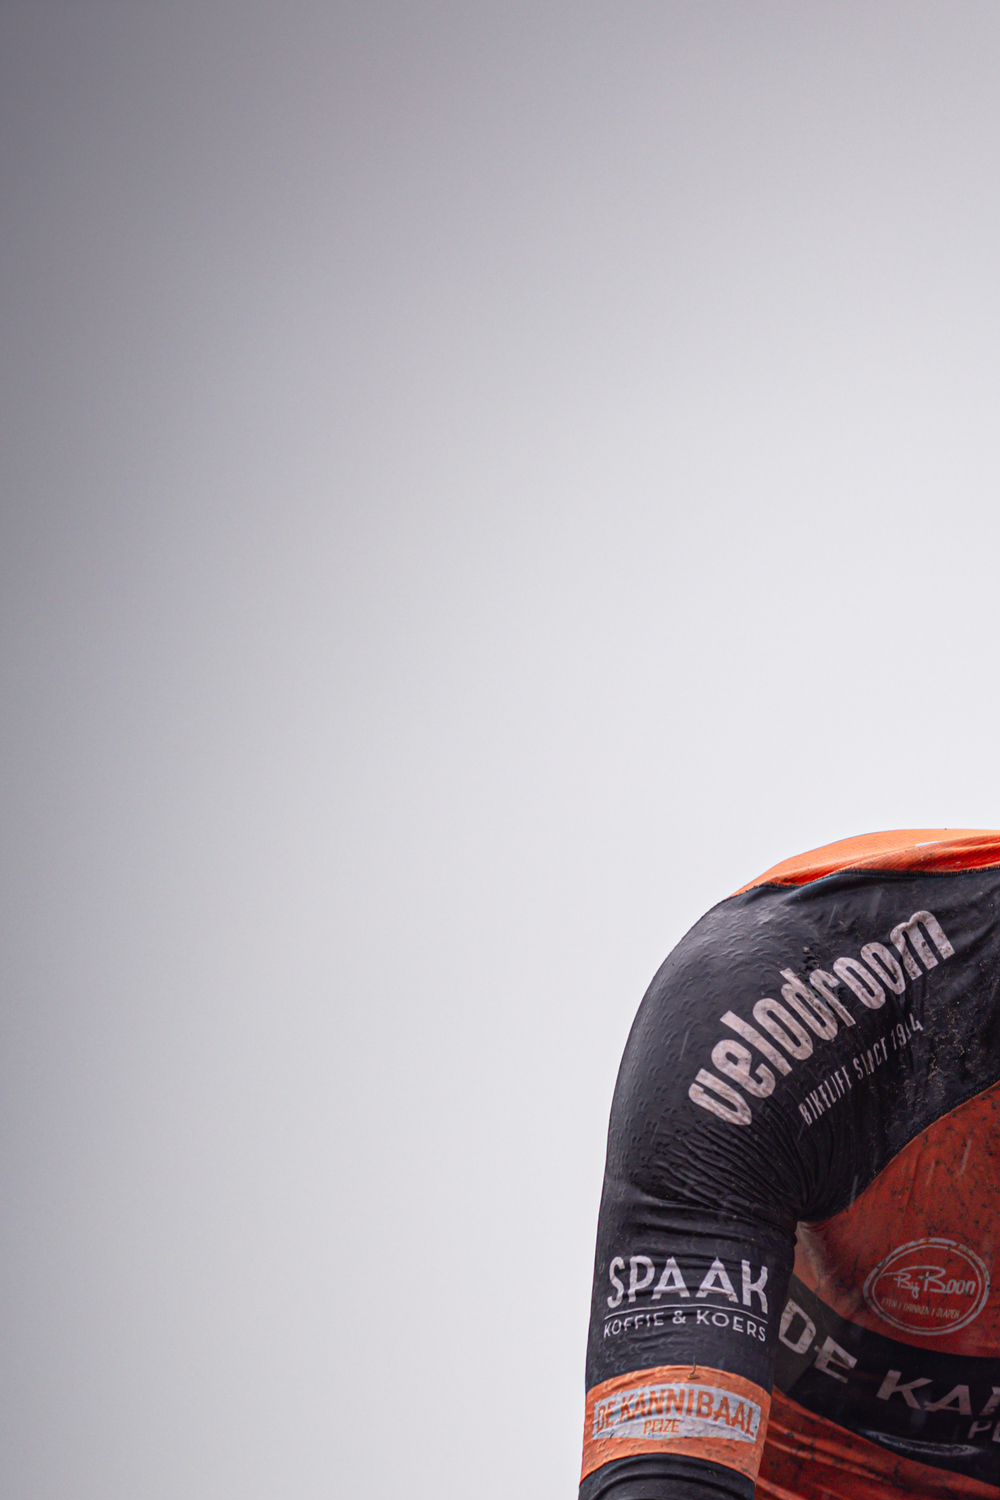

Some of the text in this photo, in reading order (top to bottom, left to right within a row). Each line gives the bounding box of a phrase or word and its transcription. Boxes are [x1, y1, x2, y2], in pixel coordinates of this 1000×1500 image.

[688, 910, 956, 1126] velodroom
[606, 1254, 769, 1315] SPAAK
[603, 1309, 767, 1342] KOFFIE & KOERS
[779, 1299, 858, 1383] DE
[595, 1388, 756, 1438] DE KANNIBAAL
[643, 1418, 682, 1434] PEIZE
